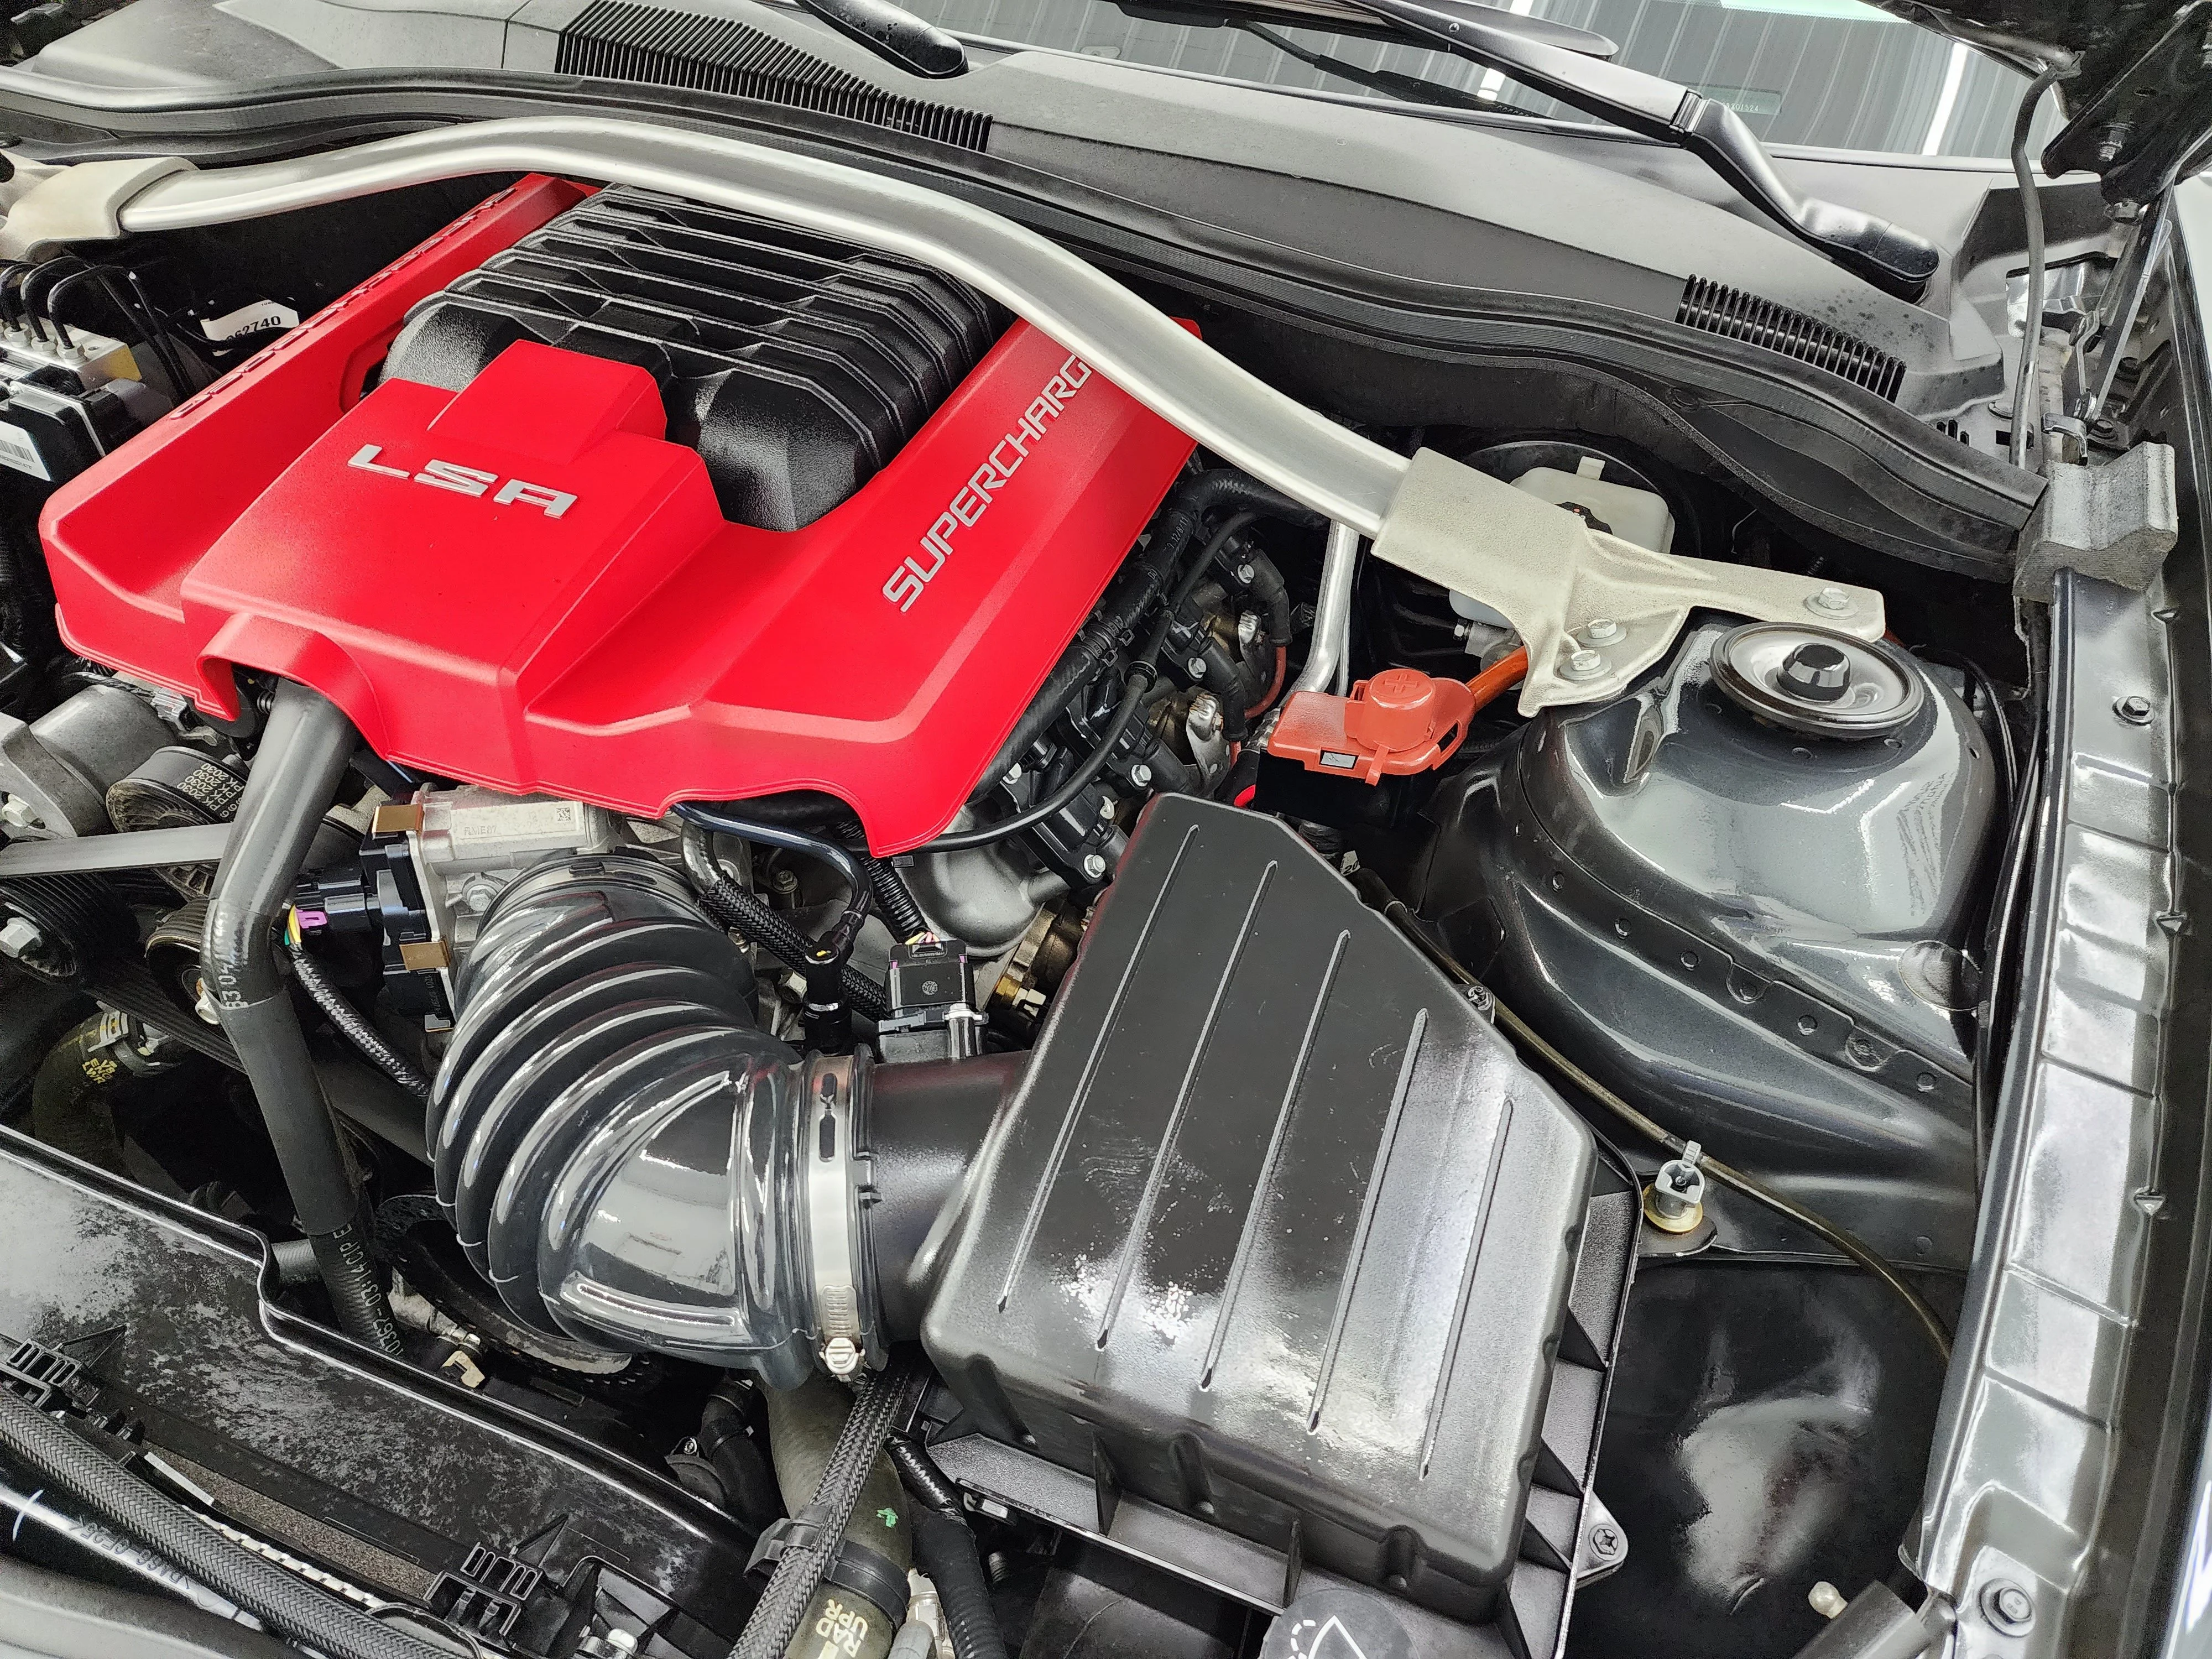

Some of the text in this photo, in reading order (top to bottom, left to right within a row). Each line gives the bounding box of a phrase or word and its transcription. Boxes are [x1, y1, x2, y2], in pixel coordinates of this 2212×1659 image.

[348, 444, 578, 519] LSA
[185, 775, 213, 793] 2030
[193, 769, 221, 787] 2030
[201, 763, 244, 792] PK 2030
[176, 782, 205, 800] 2030
[210, 790, 229, 805] PK
[218, 783, 237, 799] PK
[202, 796, 221, 811] PK
[82, 1061, 106, 1084] LWR
[825, 1598, 868, 1641] UPR
[816, 1617, 862, 1658] RAD
